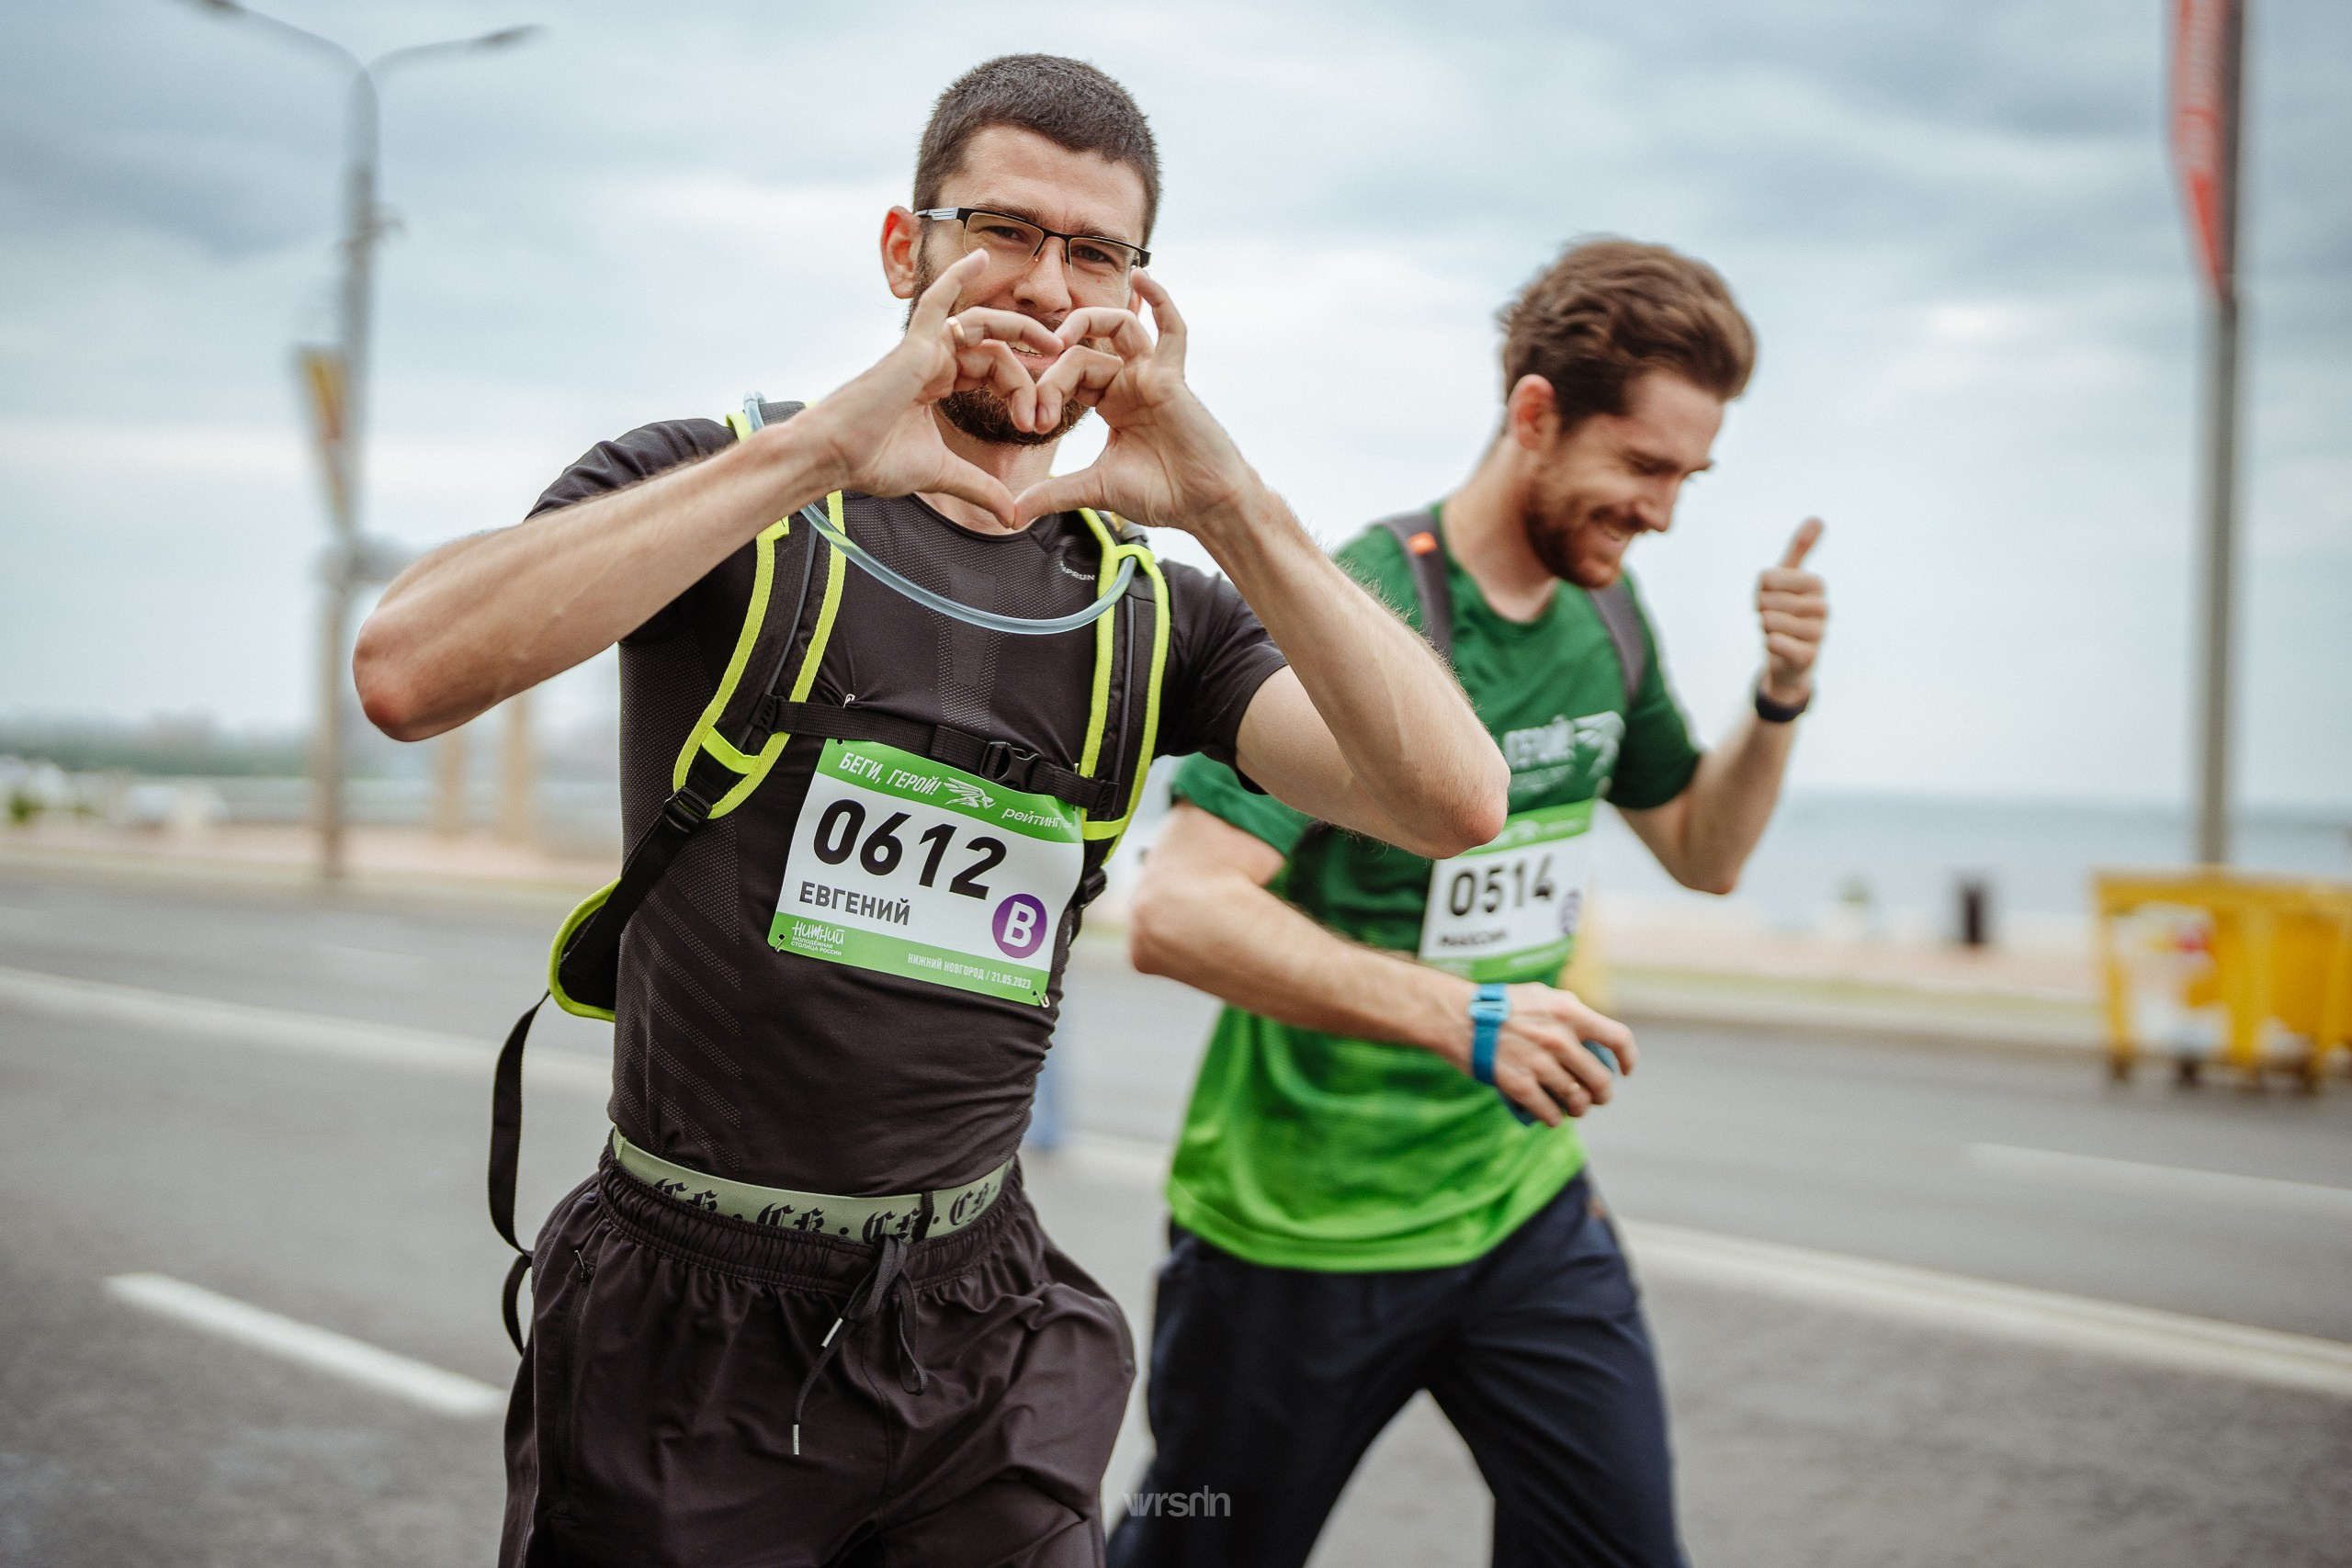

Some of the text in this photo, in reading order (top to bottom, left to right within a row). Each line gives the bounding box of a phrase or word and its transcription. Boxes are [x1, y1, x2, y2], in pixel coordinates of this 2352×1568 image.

[838, 751, 943, 795] БЕГИ, ГЕРОЙ!
[813, 798, 1007, 900] 0612
[798, 880, 910, 926] ЕВГЕНИЙ
[1450, 849, 1556, 917] 0514
[791, 942, 842, 956] СТОЛИЦА РОССИИ
[907, 953, 943, 970] НИЖНИЙ
[944, 961, 984, 981] НОВГОРОД
[991, 972, 1032, 989] 21.05.2023
